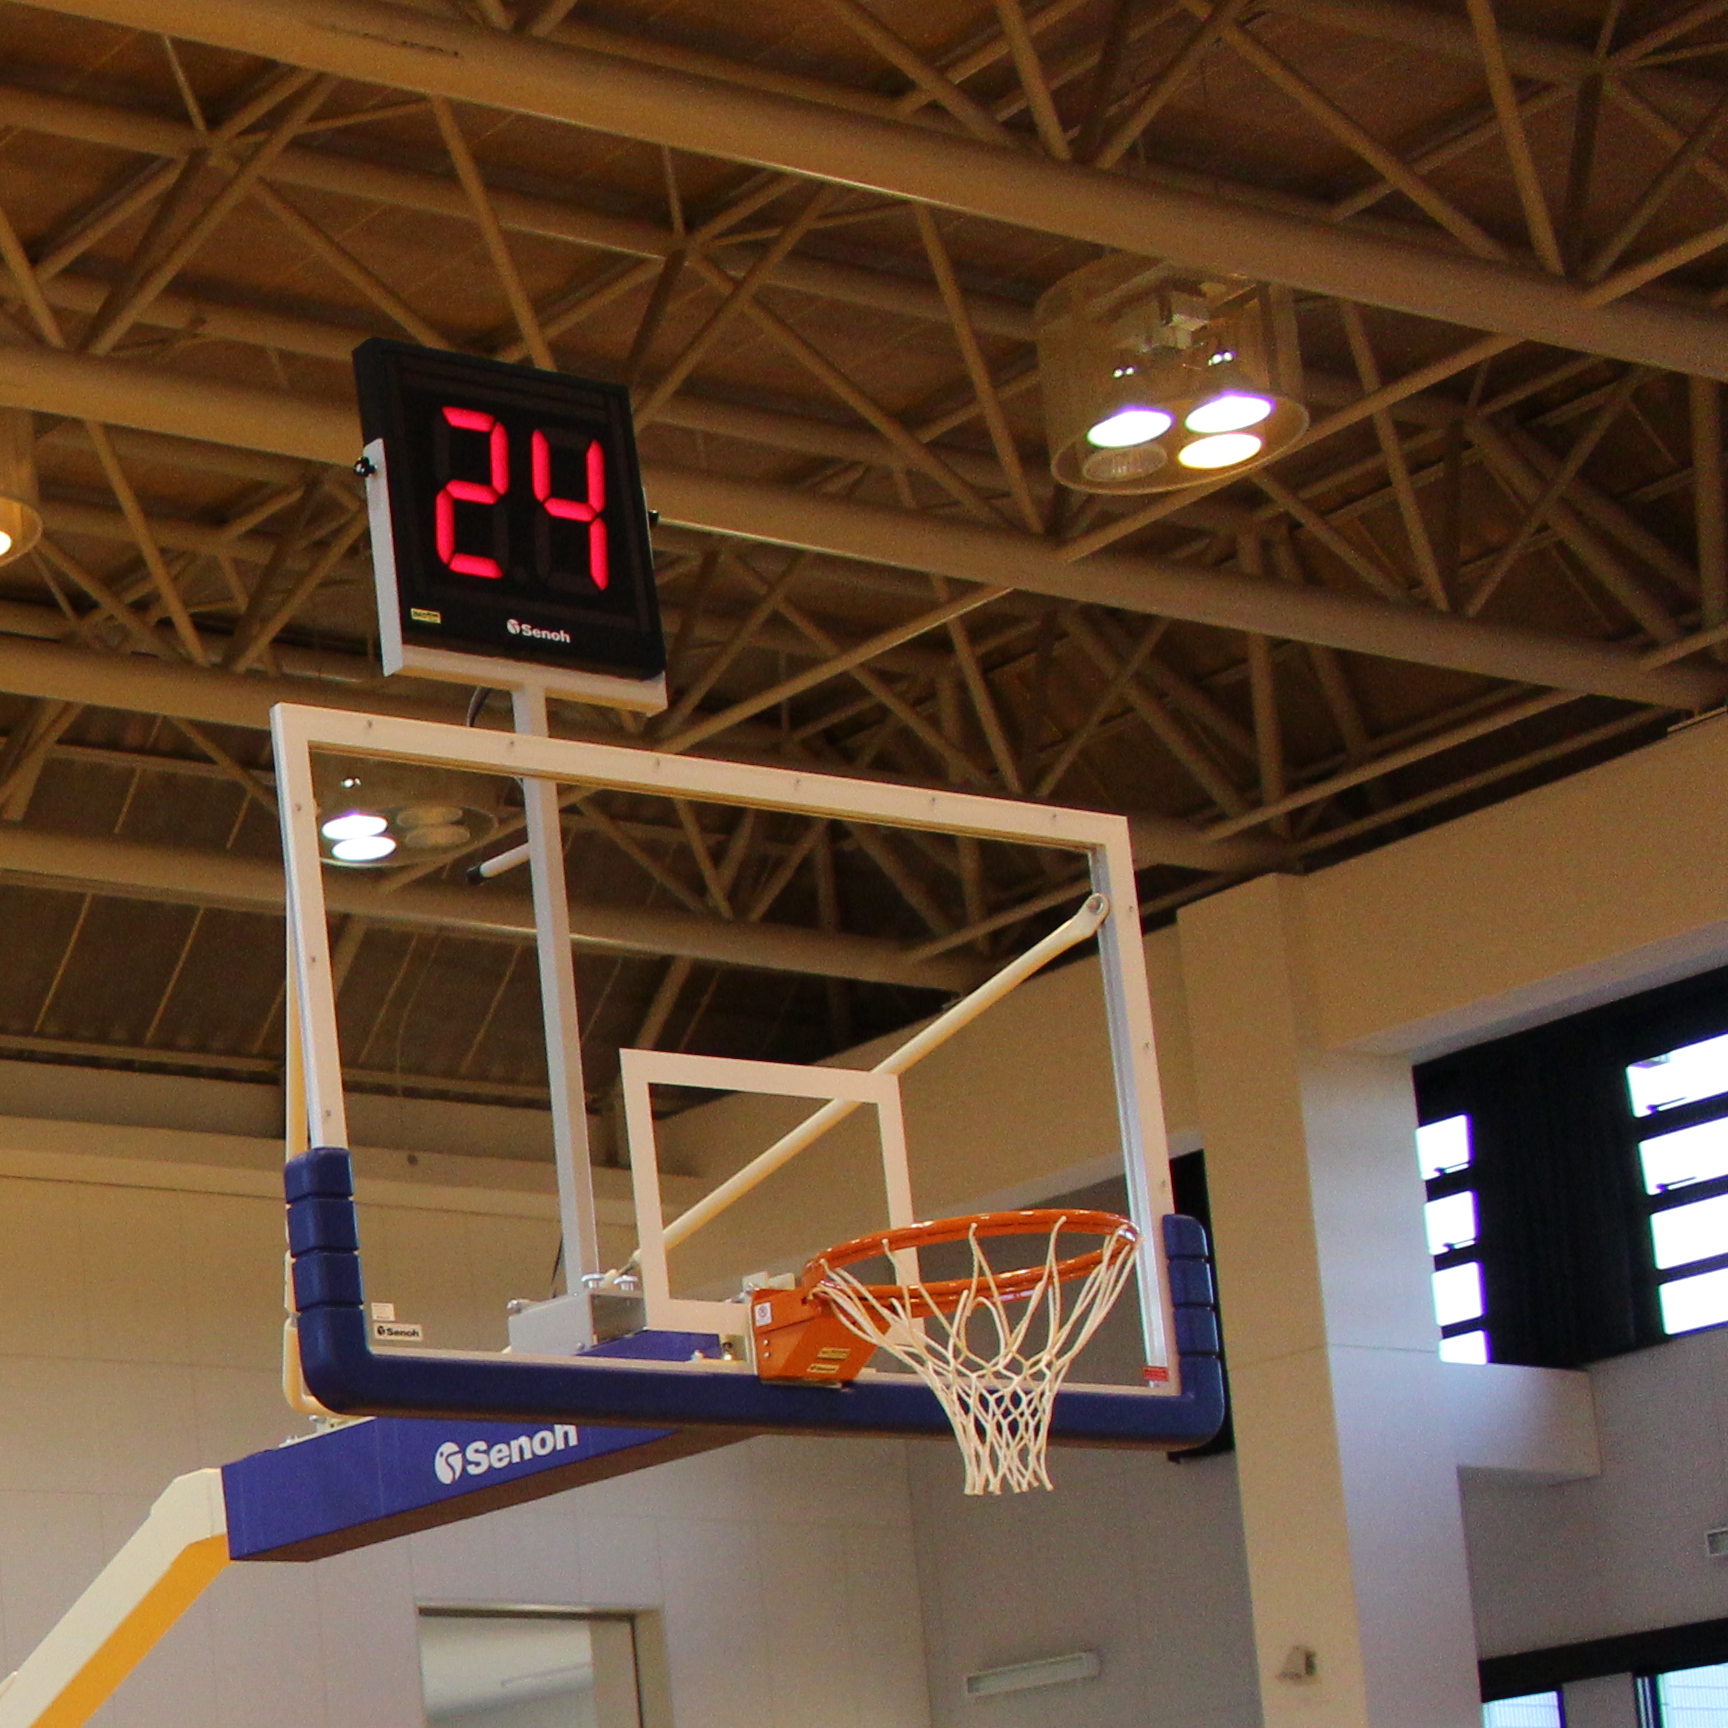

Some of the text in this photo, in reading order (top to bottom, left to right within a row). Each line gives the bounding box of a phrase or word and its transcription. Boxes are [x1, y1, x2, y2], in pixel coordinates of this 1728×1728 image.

[434, 405, 609, 591] 24
[521, 623, 571, 644] Senoh
[464, 1424, 579, 1476] Senoh
